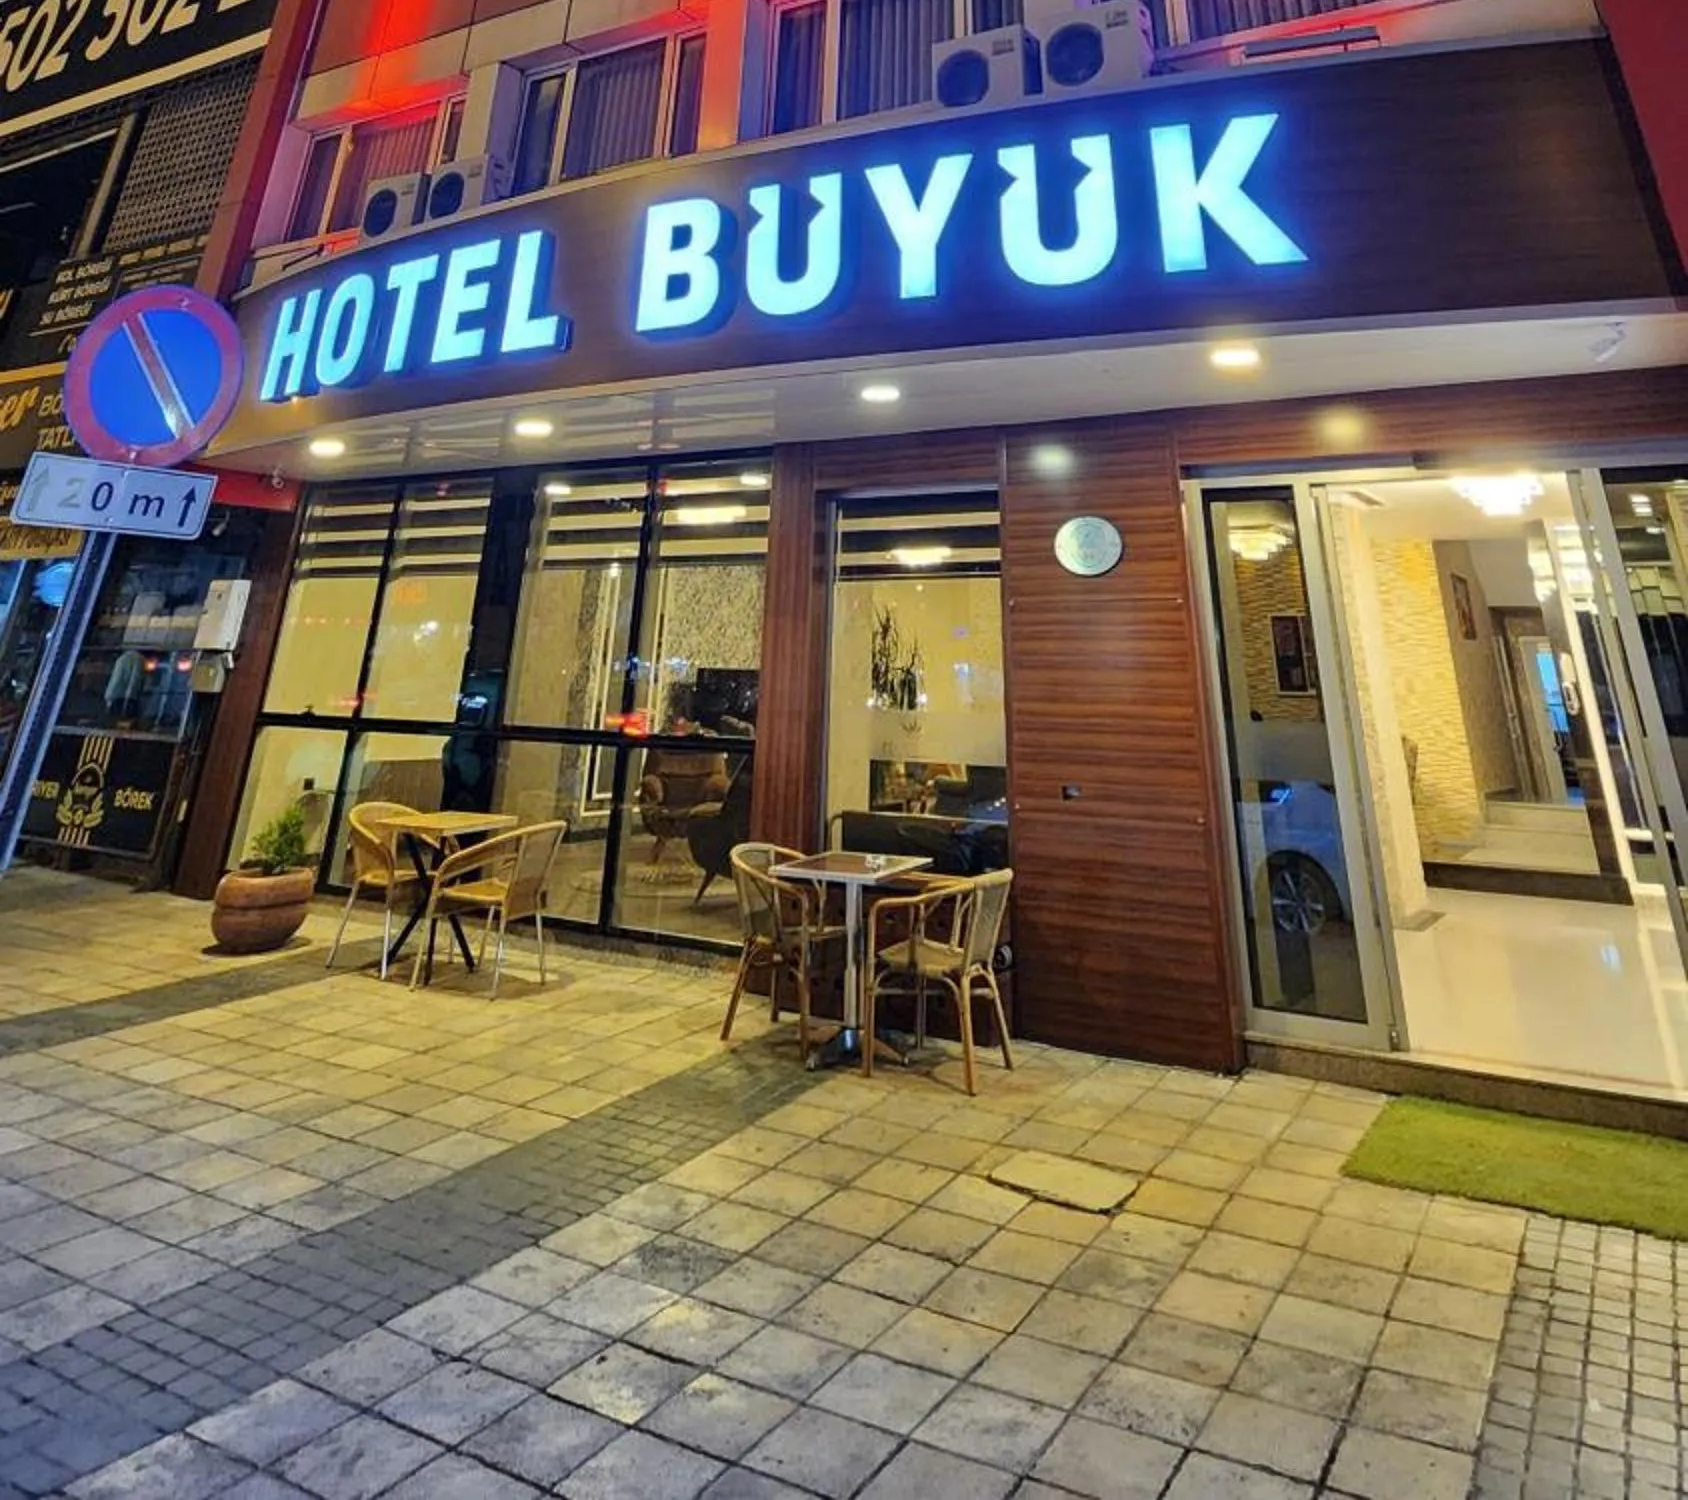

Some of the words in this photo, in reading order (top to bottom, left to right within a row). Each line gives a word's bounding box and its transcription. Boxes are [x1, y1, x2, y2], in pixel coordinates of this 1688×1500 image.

[259, 229, 560, 402] HOTEL
[58, 477, 114, 512] 20
[127, 493, 166, 519] m
